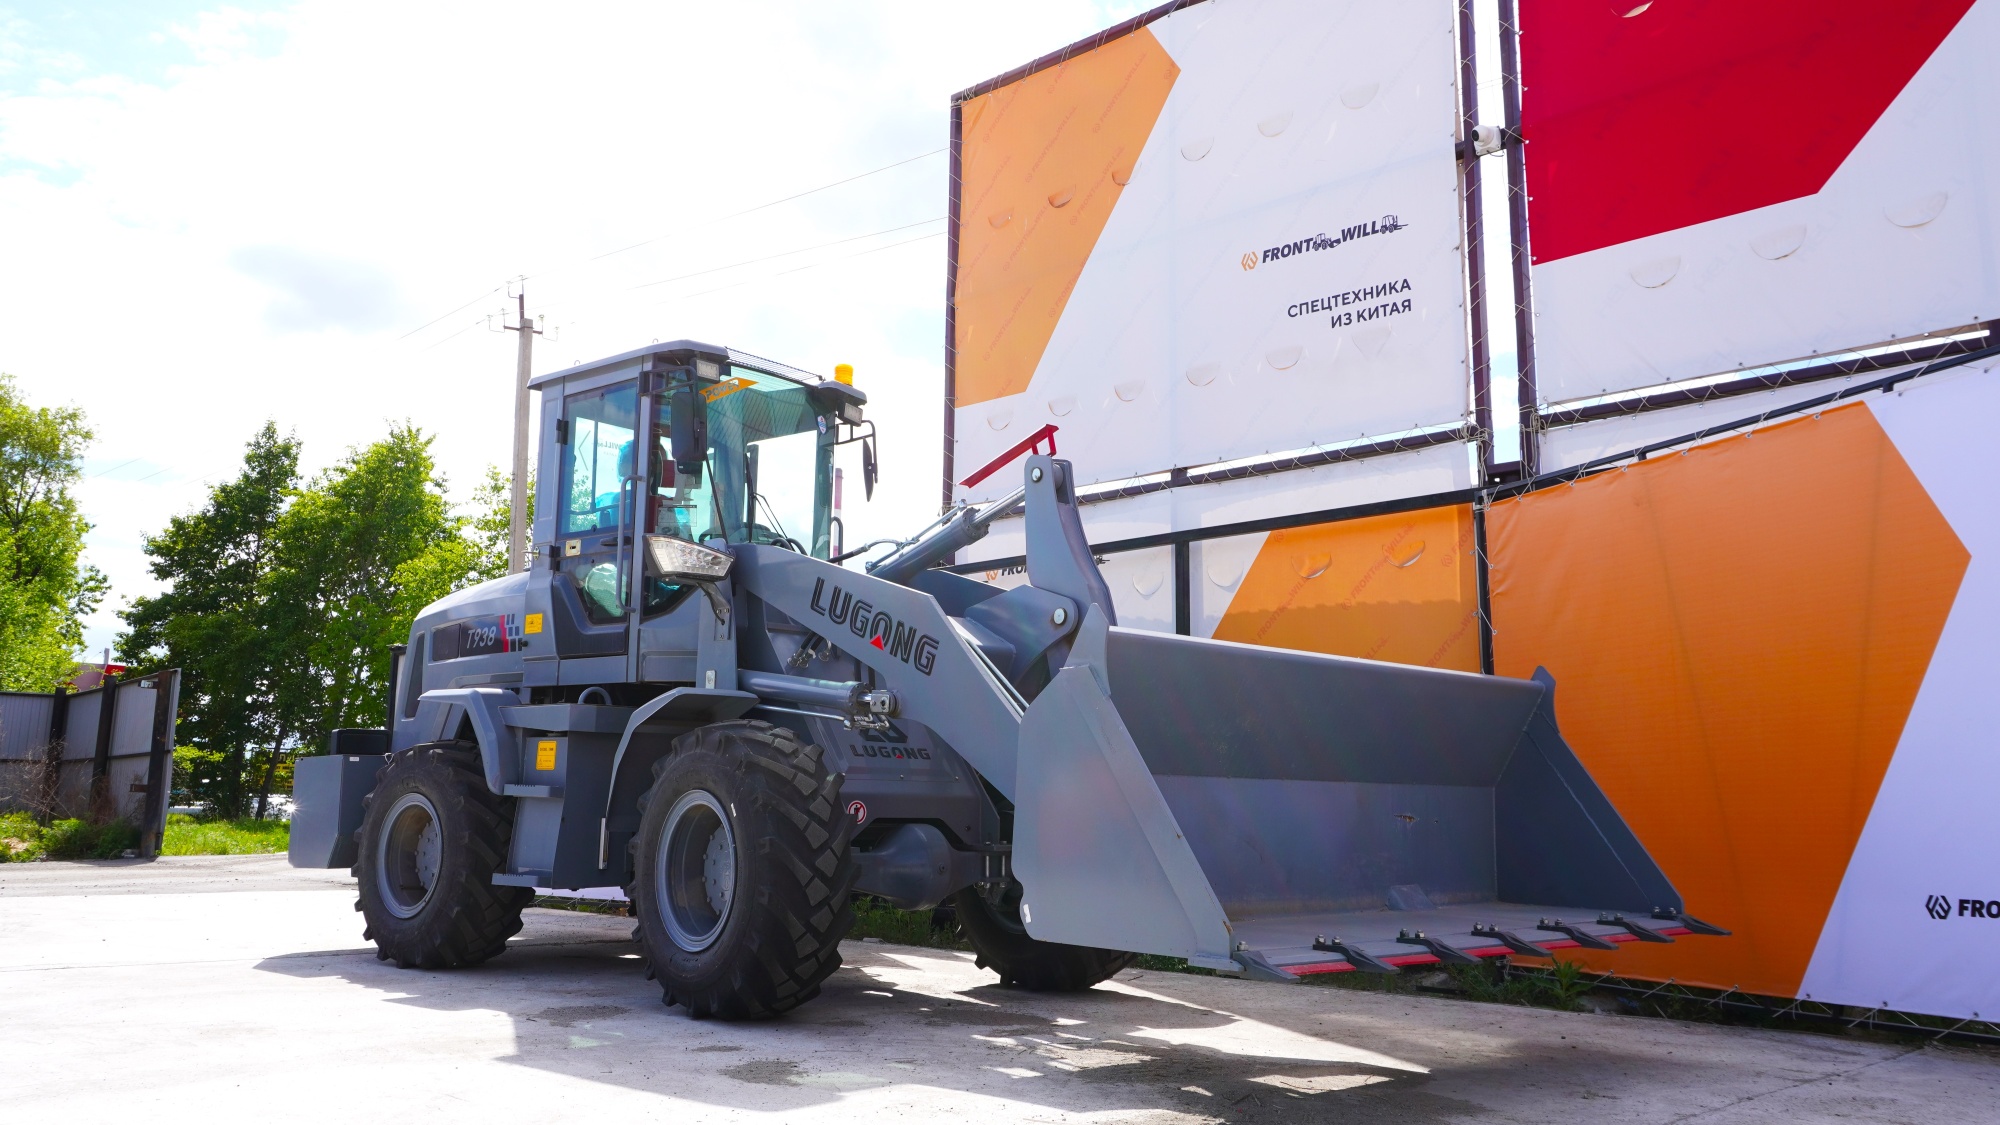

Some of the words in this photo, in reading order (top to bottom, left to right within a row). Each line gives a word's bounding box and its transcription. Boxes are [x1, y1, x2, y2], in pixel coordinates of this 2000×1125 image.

[1262, 237, 1313, 263] FRONT
[1341, 221, 1380, 242] WILL
[1287, 278, 1412, 318] СПЕЦТЕХНИКА
[1330, 312, 1353, 329] ИЗ
[1356, 298, 1412, 323] КИТАЯ
[466, 625, 497, 649] T938
[810, 576, 940, 677] LUGONG
[849, 744, 932, 760] LUGONG
